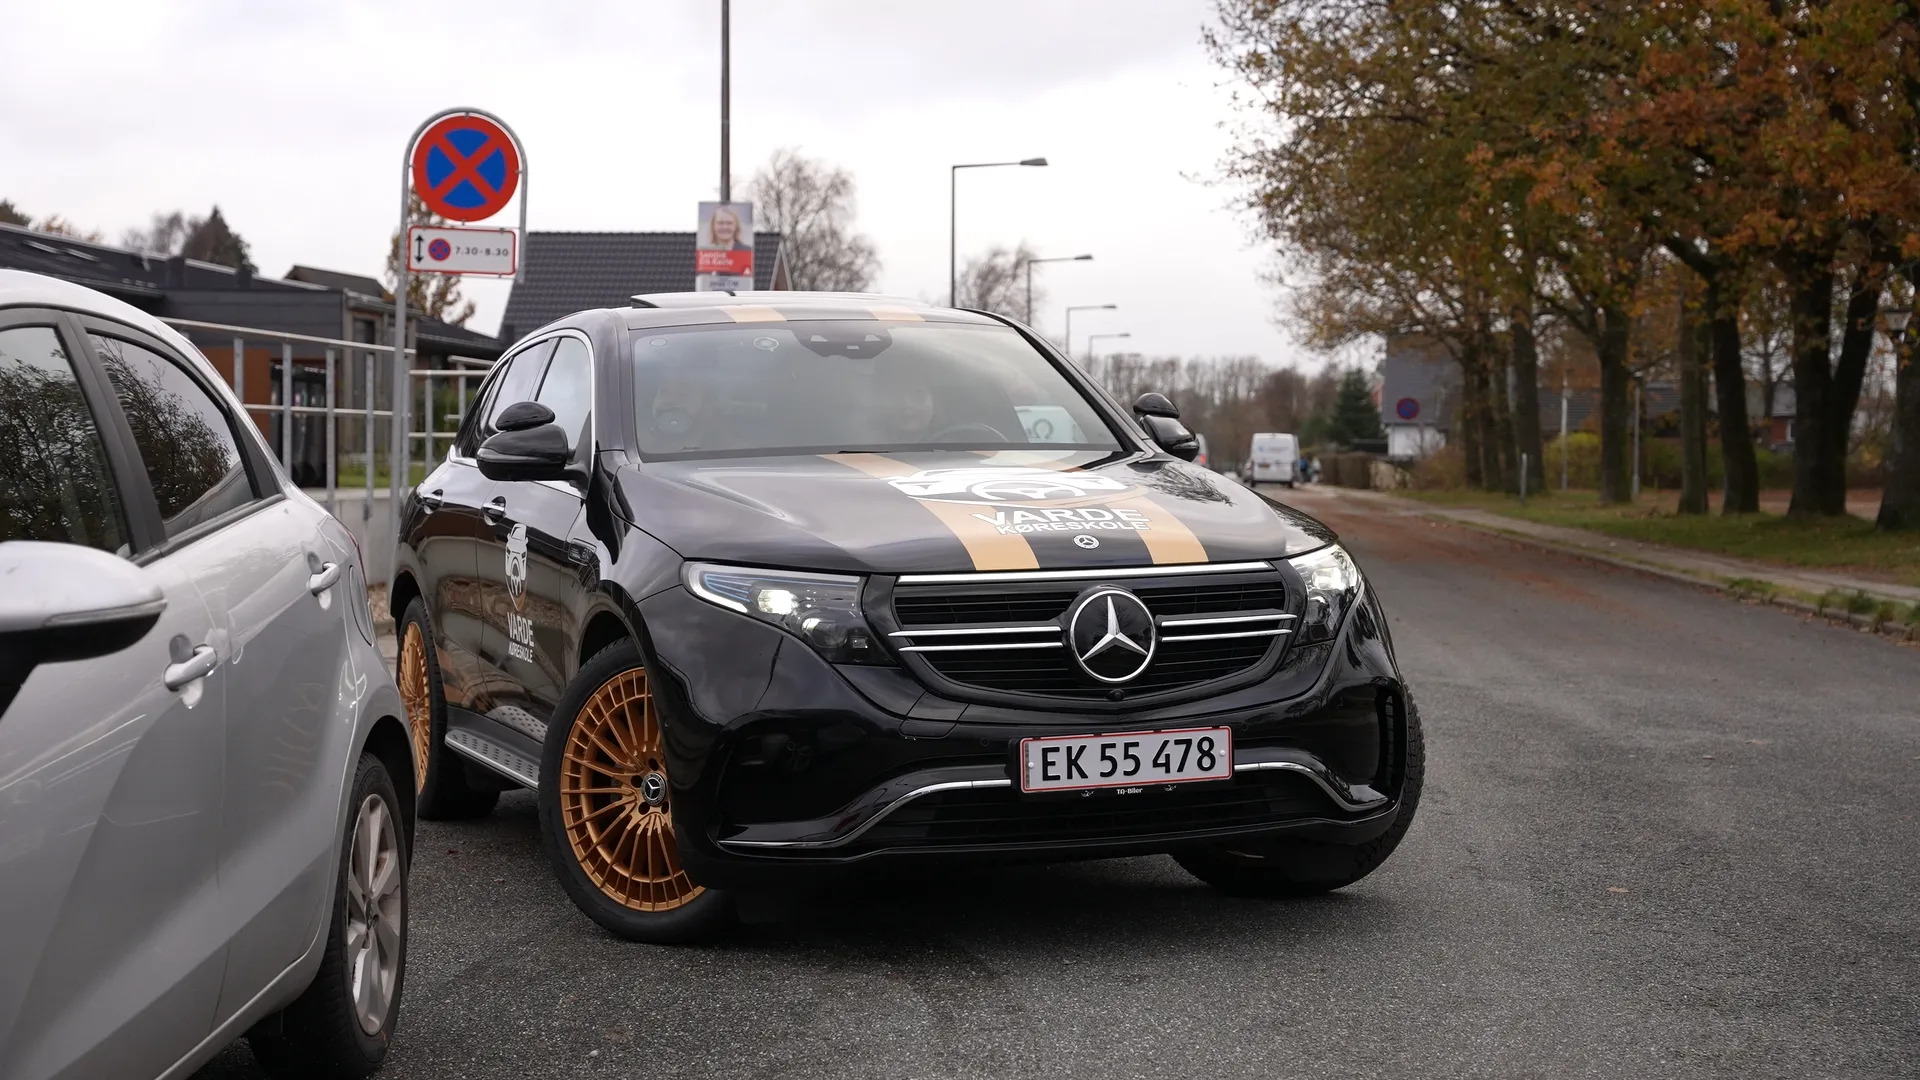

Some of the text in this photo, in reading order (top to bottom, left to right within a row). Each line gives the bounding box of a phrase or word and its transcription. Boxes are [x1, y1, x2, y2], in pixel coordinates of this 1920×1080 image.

[971, 508, 1150, 526] VARDE
[995, 521, 1151, 535] KØRESKOLE
[507, 612, 534, 647] VARDE
[1041, 736, 1217, 781] EK 55 478
